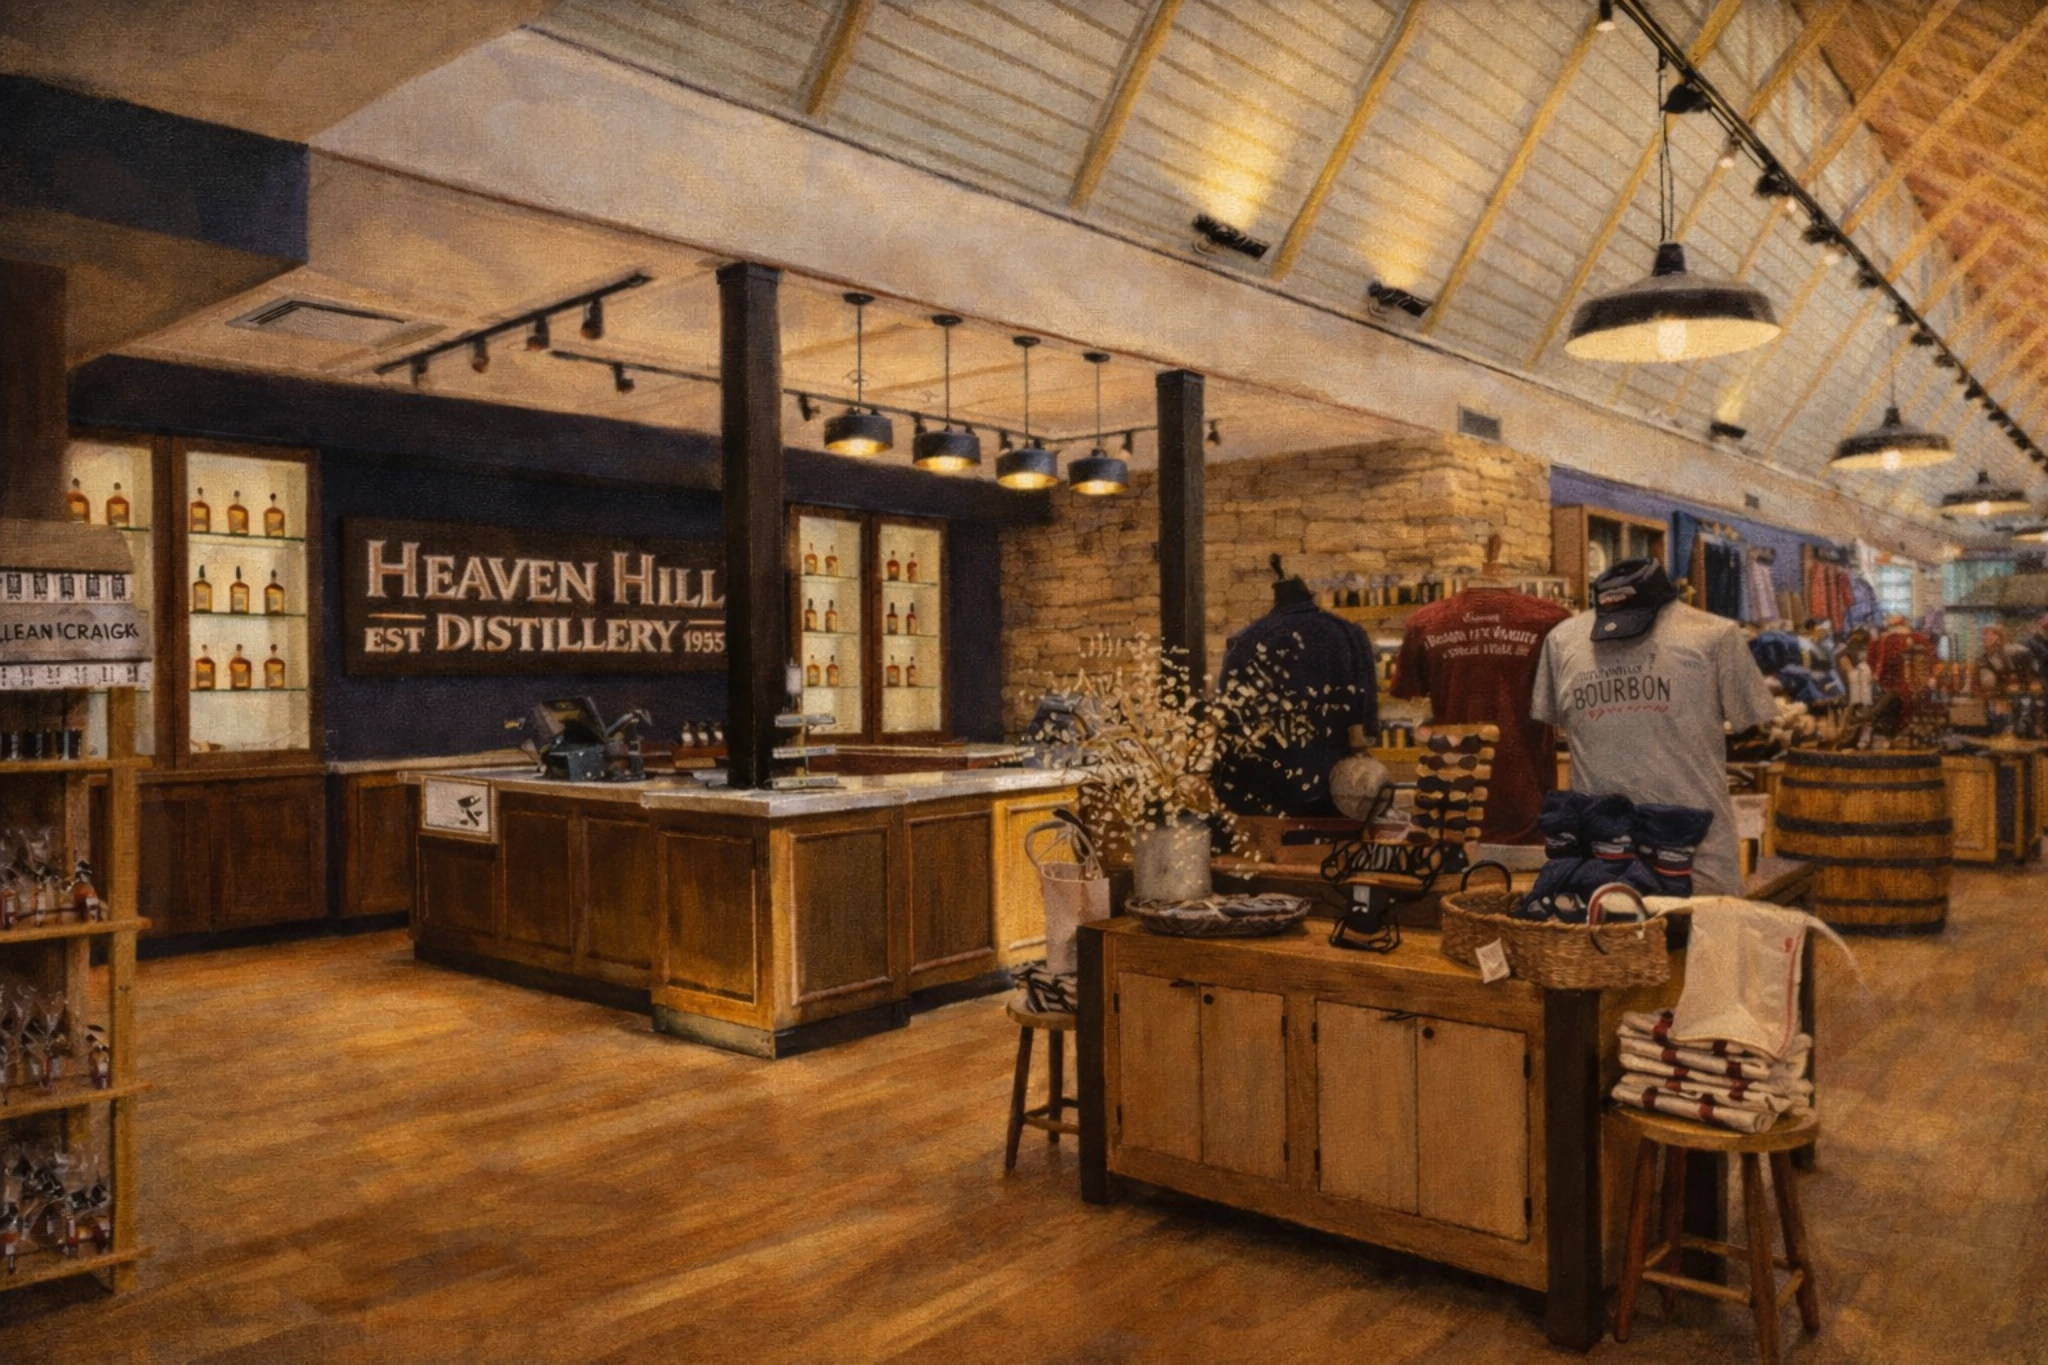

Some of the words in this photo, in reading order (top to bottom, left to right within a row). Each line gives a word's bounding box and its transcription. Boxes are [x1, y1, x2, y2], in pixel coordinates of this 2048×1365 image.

[367, 540, 598, 603] HEAVEN
[612, 551, 726, 608] HILL
[364, 627, 426, 653] EST
[436, 613, 680, 653] DISTILLERY
[683, 629, 726, 653] 1955
[1573, 674, 1671, 711] BOURBON
